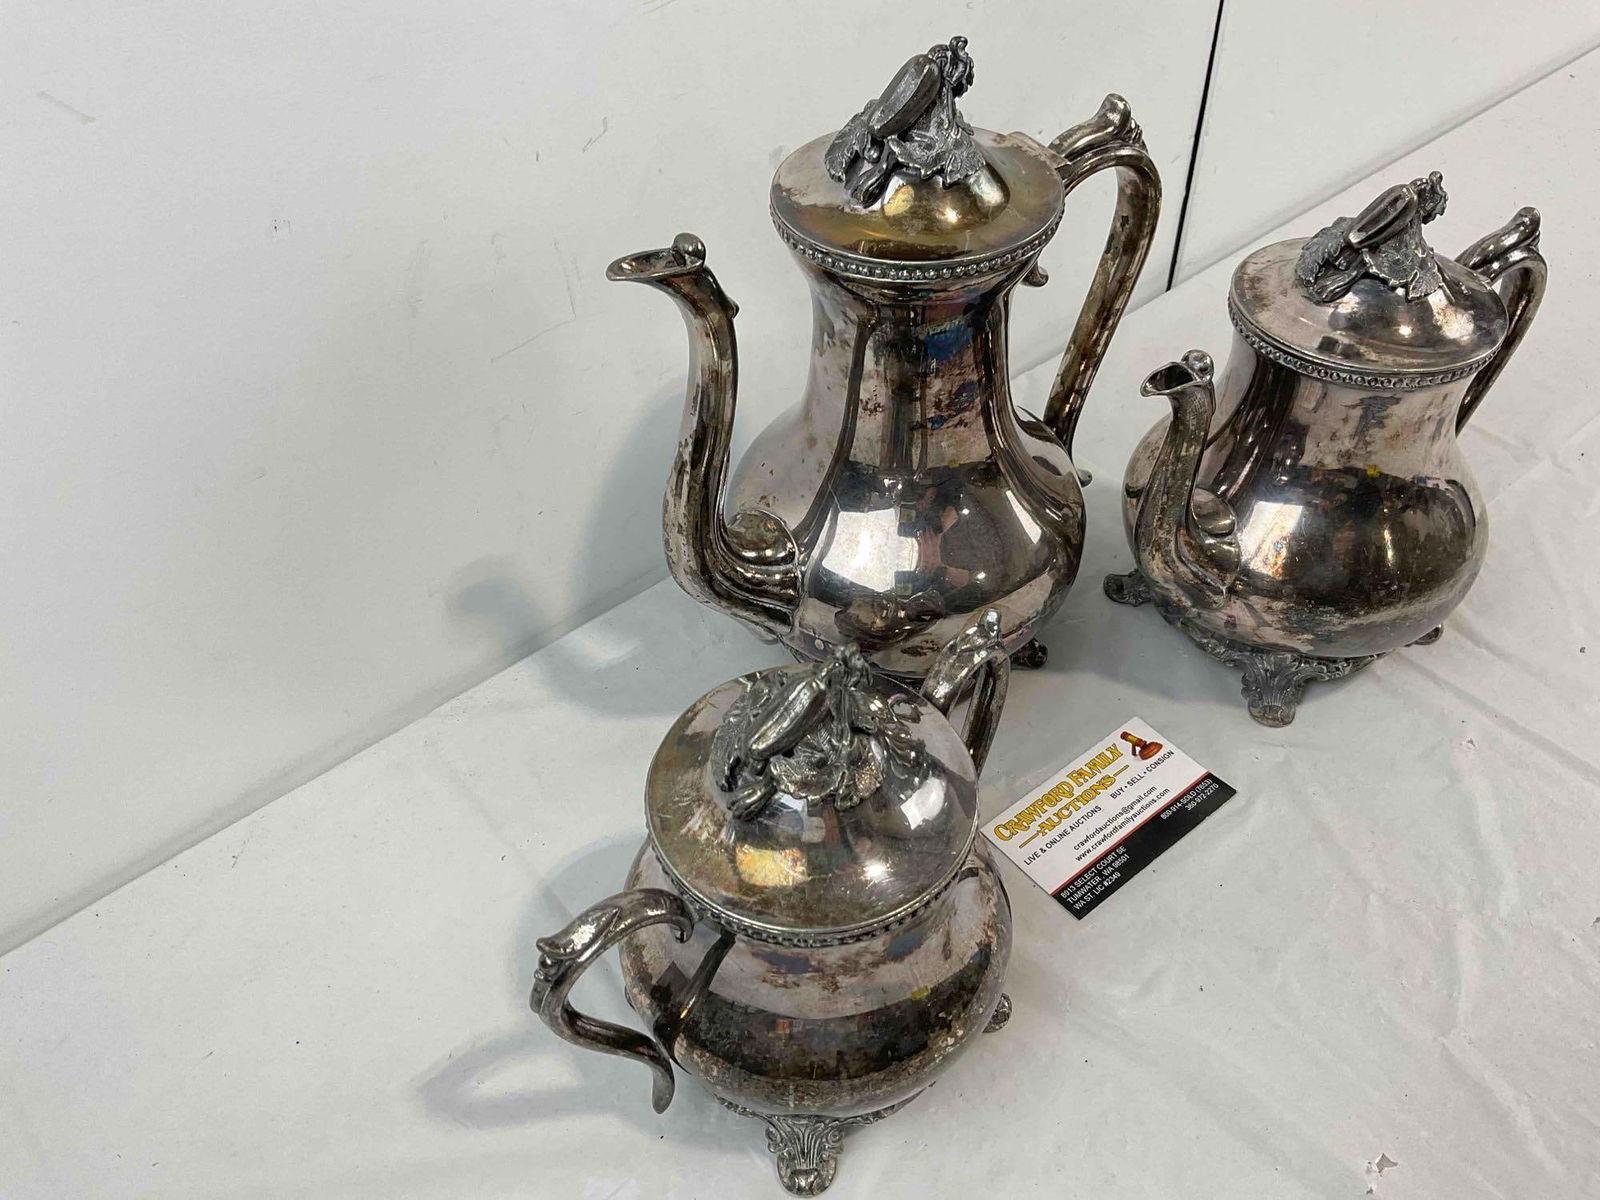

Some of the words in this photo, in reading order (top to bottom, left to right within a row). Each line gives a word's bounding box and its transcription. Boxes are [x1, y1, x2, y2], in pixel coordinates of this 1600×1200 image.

[994, 781, 1074, 841] CRAWFORD
[1066, 743, 1123, 787] FAMILY
[1038, 774, 1116, 836] AUCTIONS
[1110, 788, 1125, 800] BUY
[1127, 774, 1144, 787] SELL
[1147, 750, 1174, 772] CONSIGN
[1024, 850, 1041, 866] LIVE
[1045, 830, 1070, 849] ONLINE
[1069, 805, 1102, 837] AUCTIONS
[1073, 785, 1157, 851] crawfordauctions@gmail.com
[1075, 788, 1170, 861] www.crawfordfamilyauctions.com
[1067, 876, 1102, 903] TUMWATER
[1102, 866, 1114, 876] WA
[1073, 900, 1086, 910] WA
[1093, 884, 1105, 895] LIC
[1103, 872, 1121, 887] #2349
[1074, 869, 1098, 888] SELECT
[1096, 853, 1117, 870] COURT
[1116, 845, 1127, 854] SE
